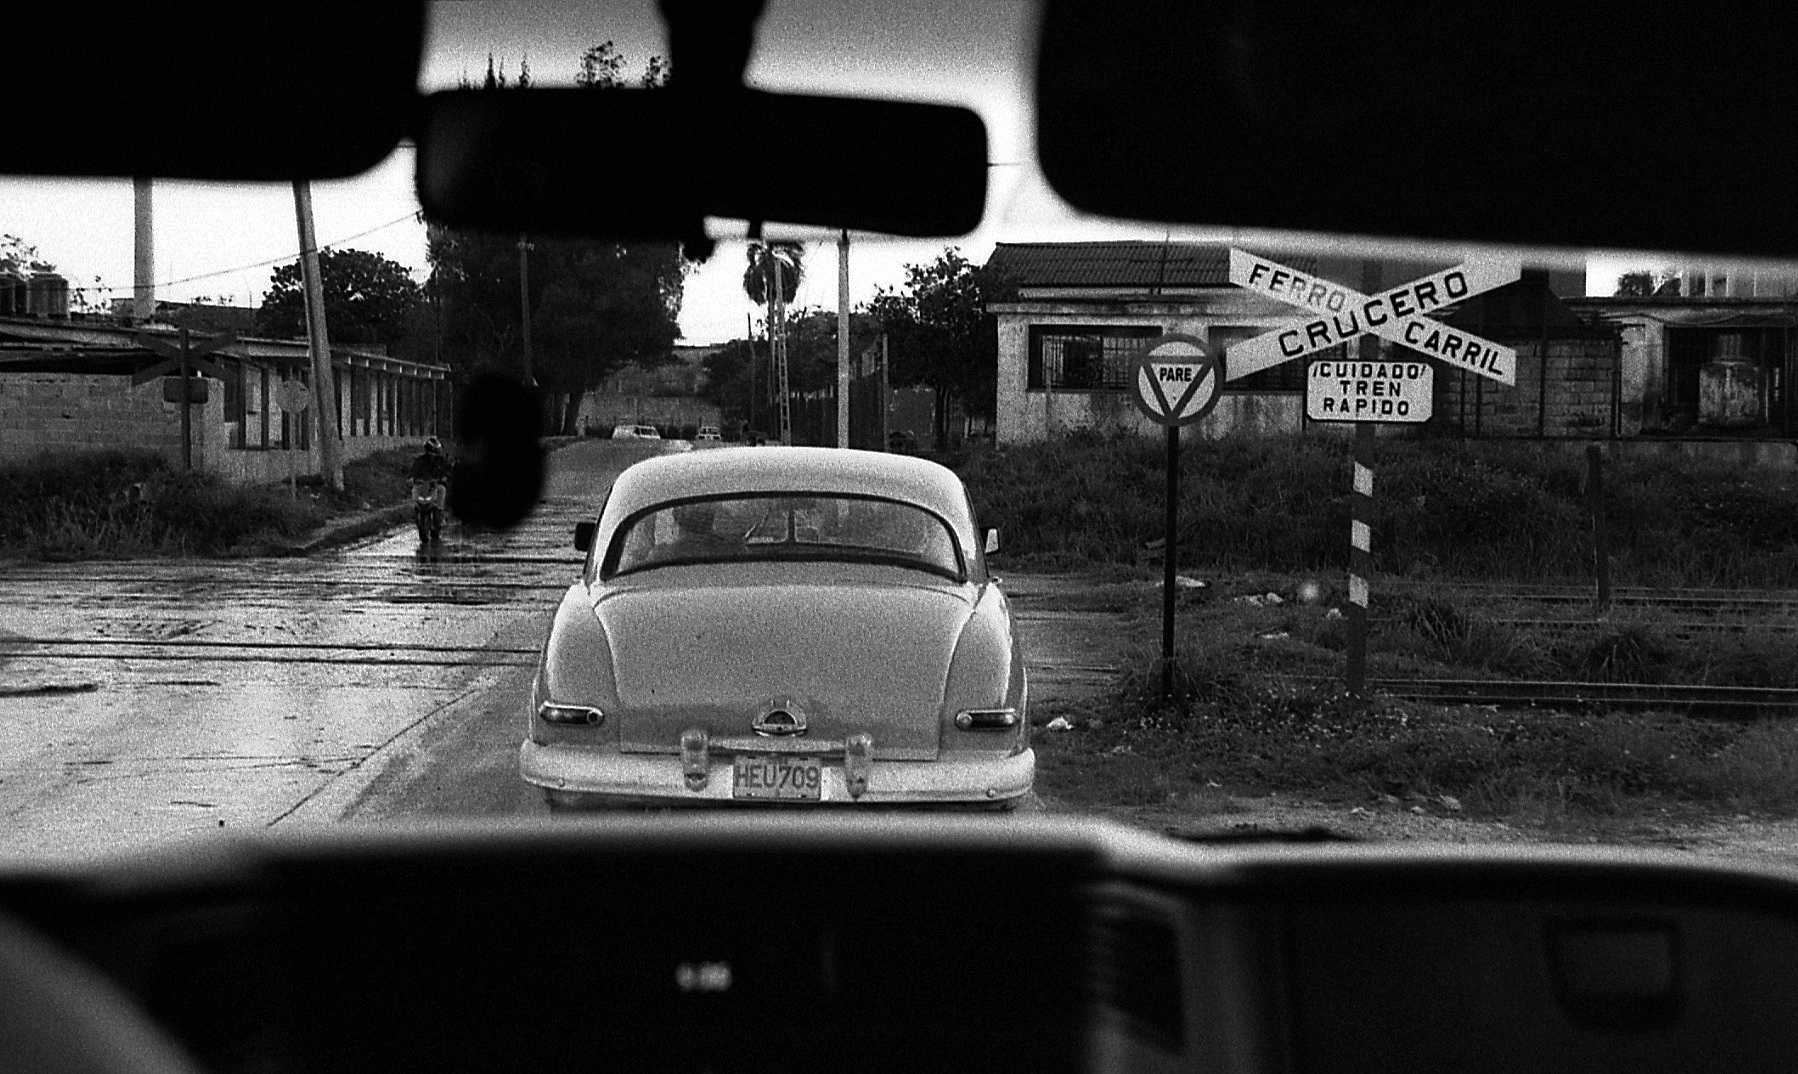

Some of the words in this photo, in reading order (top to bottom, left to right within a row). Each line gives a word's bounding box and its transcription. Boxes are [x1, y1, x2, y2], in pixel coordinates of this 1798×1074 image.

[1248, 263, 1346, 313] FERRO
[1404, 320, 1503, 376] CARRIL
[1278, 271, 1469, 357] CRUCERO
[1160, 367, 1192, 382] PARE
[1340, 380, 1401, 397] TREN
[1323, 397, 1409, 415] RAPIDO
[735, 764, 819, 789] HEU709
